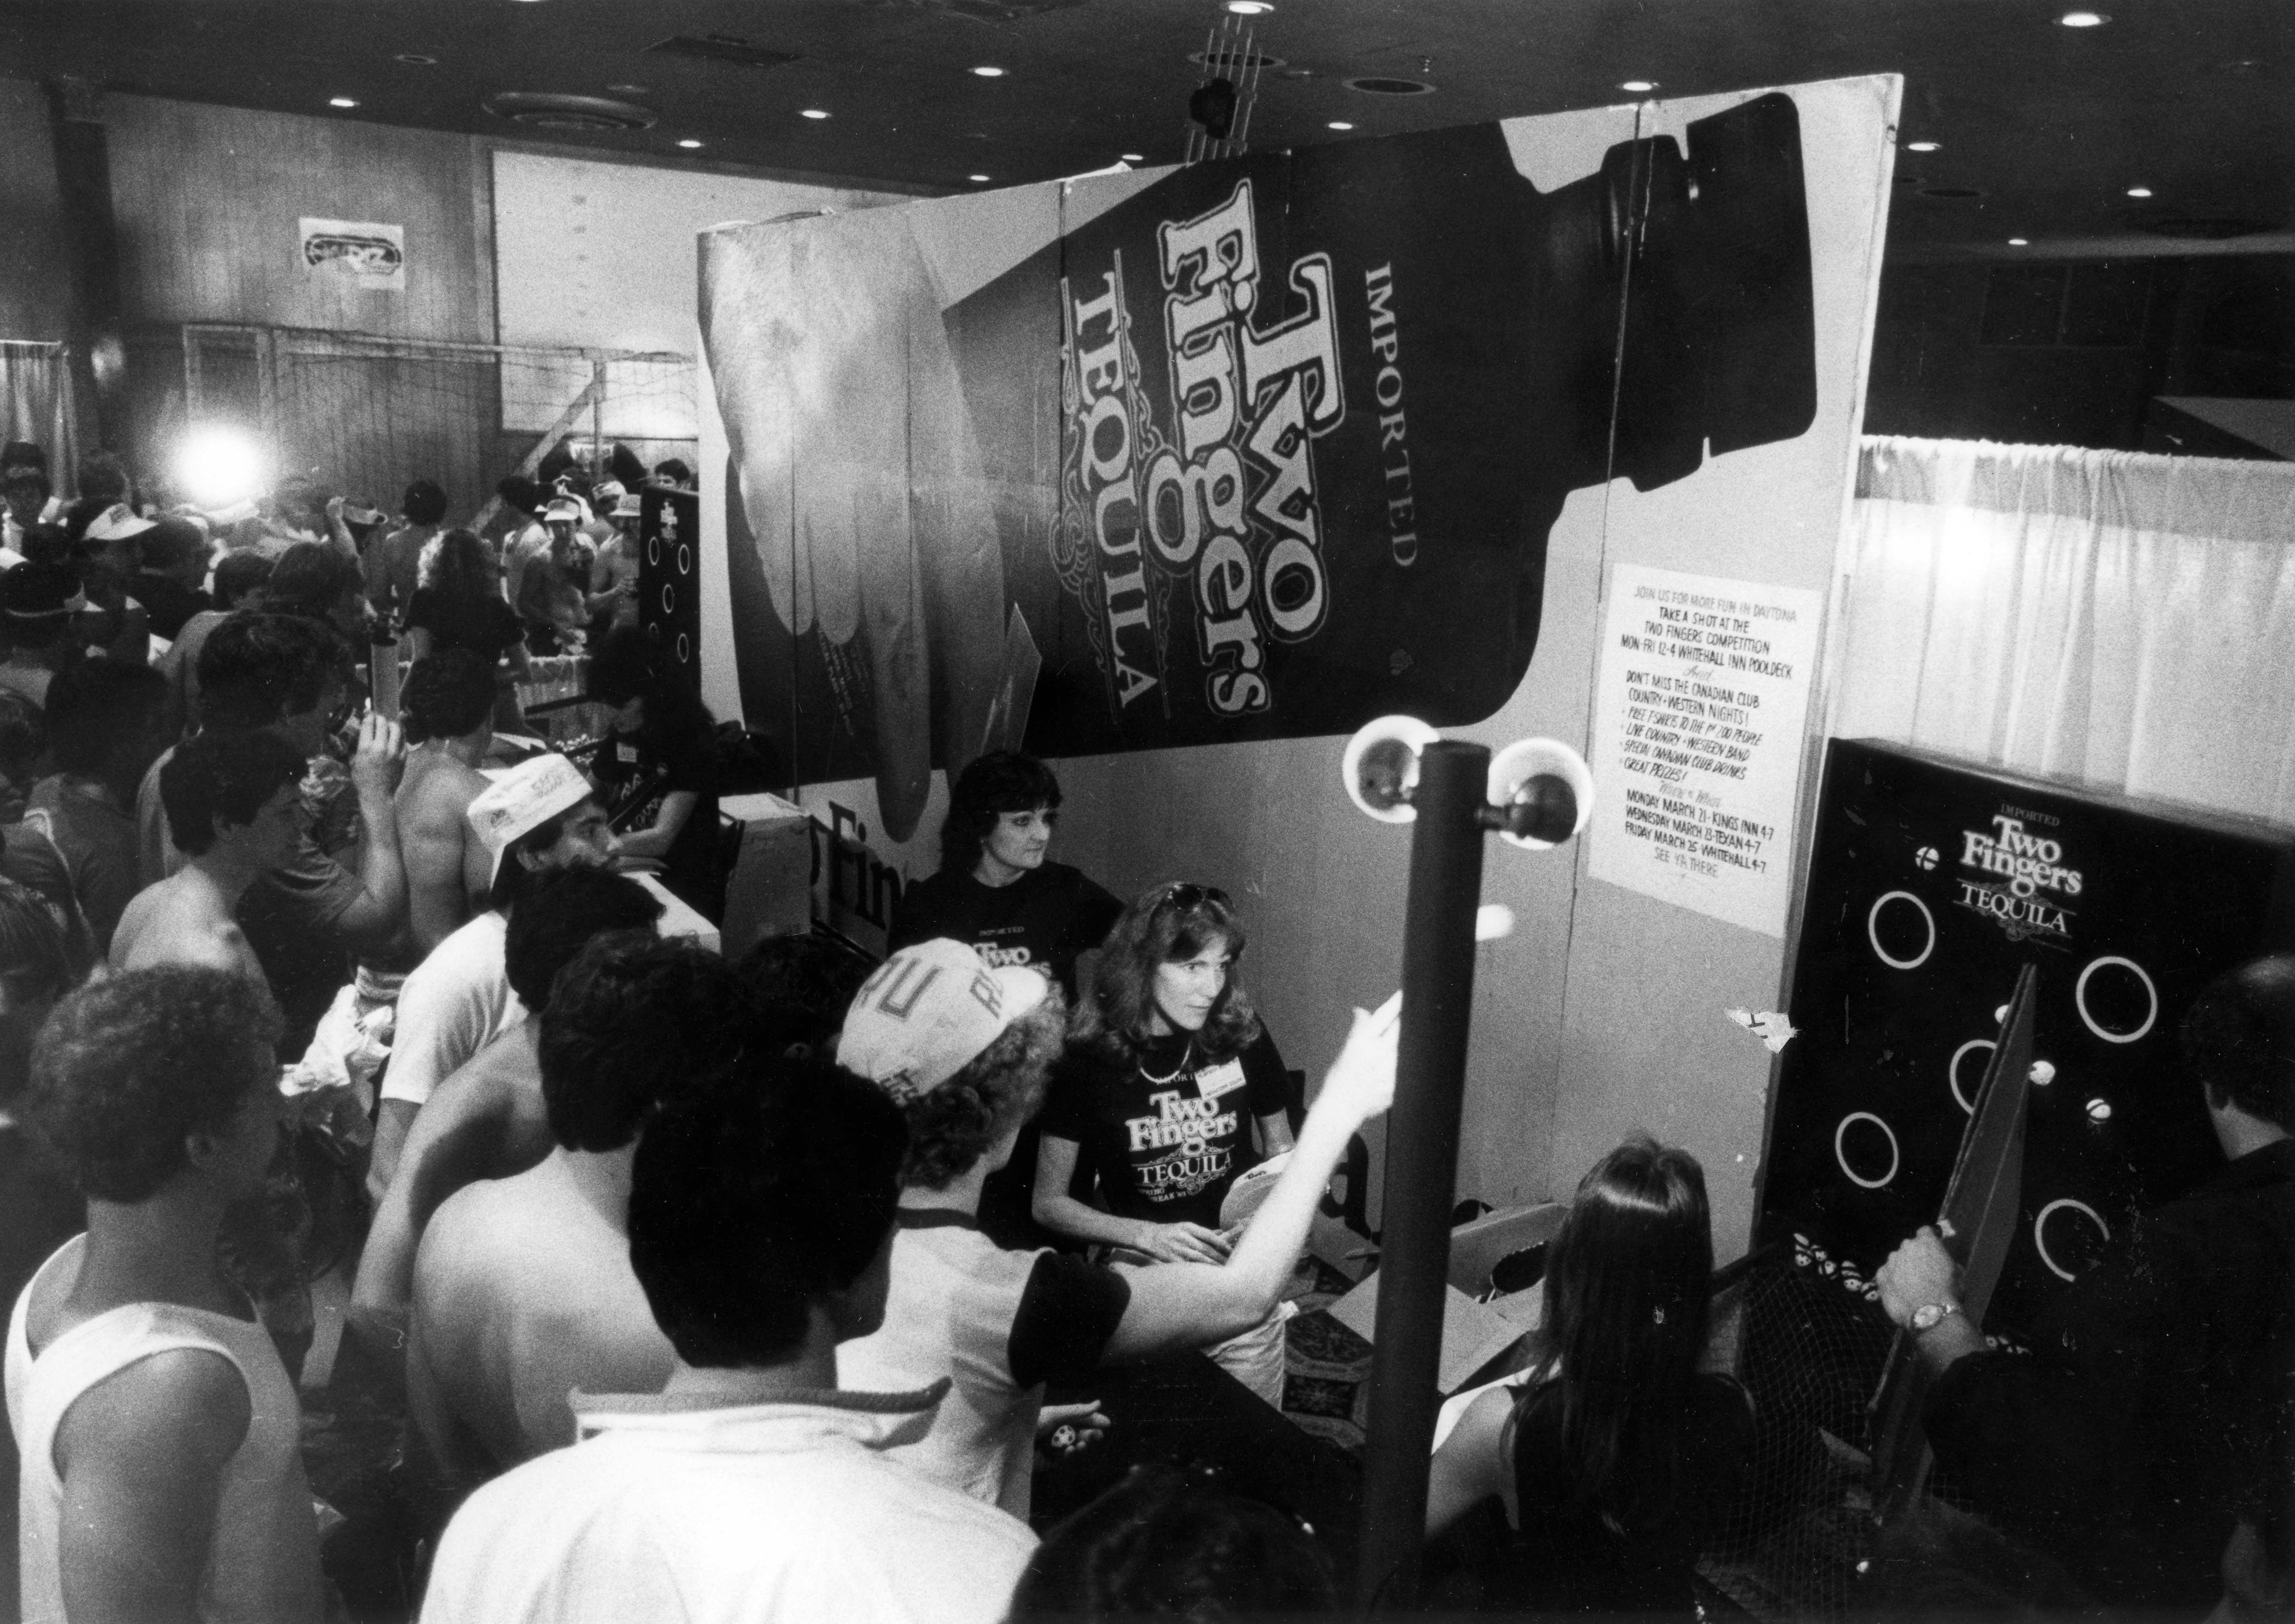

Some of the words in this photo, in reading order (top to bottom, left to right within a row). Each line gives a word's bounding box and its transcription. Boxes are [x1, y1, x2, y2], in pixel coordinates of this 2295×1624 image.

[1365, 261, 1419, 568] IMPORTED
[1143, 180, 1271, 714] Fingers
[1241, 255, 1344, 640] Two
[1075, 272, 1157, 709] TEQUILA
[1634, 586, 1655, 599] JOIN
[1657, 589, 1670, 602] US
[1672, 592, 1689, 603] FOR
[1690, 594, 1715, 610] MORE
[1718, 598, 1736, 613] FUN
[1753, 603, 1796, 621] DAYTONA
[1659, 606, 1681, 621] TAKE
[1682, 611, 1688, 622] A
[1692, 612, 1718, 627] SHOT
[1719, 617, 1730, 630] AT
[1733, 619, 1750, 633] THE
[1645, 620, 1663, 636] TWO
[1666, 624, 1703, 643] FINGERS
[1706, 632, 1770, 655] COMPETITION
[1678, 644, 1724, 666] WHITEHALL
[1728, 653, 1747, 671] INN
[1651, 675, 1672, 691] MISS
[1674, 679, 1689, 694] THE
[1692, 682, 1734, 703] CANADIAN
[1737, 692, 1759, 709] CLUB
[1626, 722, 1646, 737] LIVE
[1725, 745, 1750, 761] BAND
[1628, 706, 1646, 721] FREE
[1679, 716, 1690, 730] TO
[1690, 719, 1706, 734] THE
[1732, 728, 1763, 746] PEOPLE
[1624, 740, 1651, 756] SPECIAL
[1652, 746, 1692, 765] CANADIAN
[1691, 755, 1714, 771] CLUB
[1712, 761, 1747, 780] DRINKS
[1624, 757, 1651, 773] GREAT
[1626, 804, 1669, 829] WEDNESDAY
[1673, 818, 1702, 839] MARCH
[1745, 839, 1761, 854] 4-7
[1627, 788, 1660, 809] MONDAY
[1662, 798, 1696, 819] MARCH
[1741, 820, 1759, 837] INN
[2001, 804, 2060, 826] IMPORTED
[1625, 820, 1652, 840] FRIDAY
[1654, 830, 1685, 848] MARCH
[1701, 843, 1751, 869] WHITEHALL
[1752, 859, 1767, 873] 4-7
[1654, 847, 1670, 863] SEE
[1992, 814, 2062, 864] Two
[1959, 830, 2083, 898] Fingers
[1961, 883, 2066, 933] TEQUILA
[973, 942, 1031, 969] Two
[1149, 1089, 1219, 1123] Two
[1125, 1110, 1237, 1156] Fingers
[1137, 1151, 1231, 1183] TEQUILA
